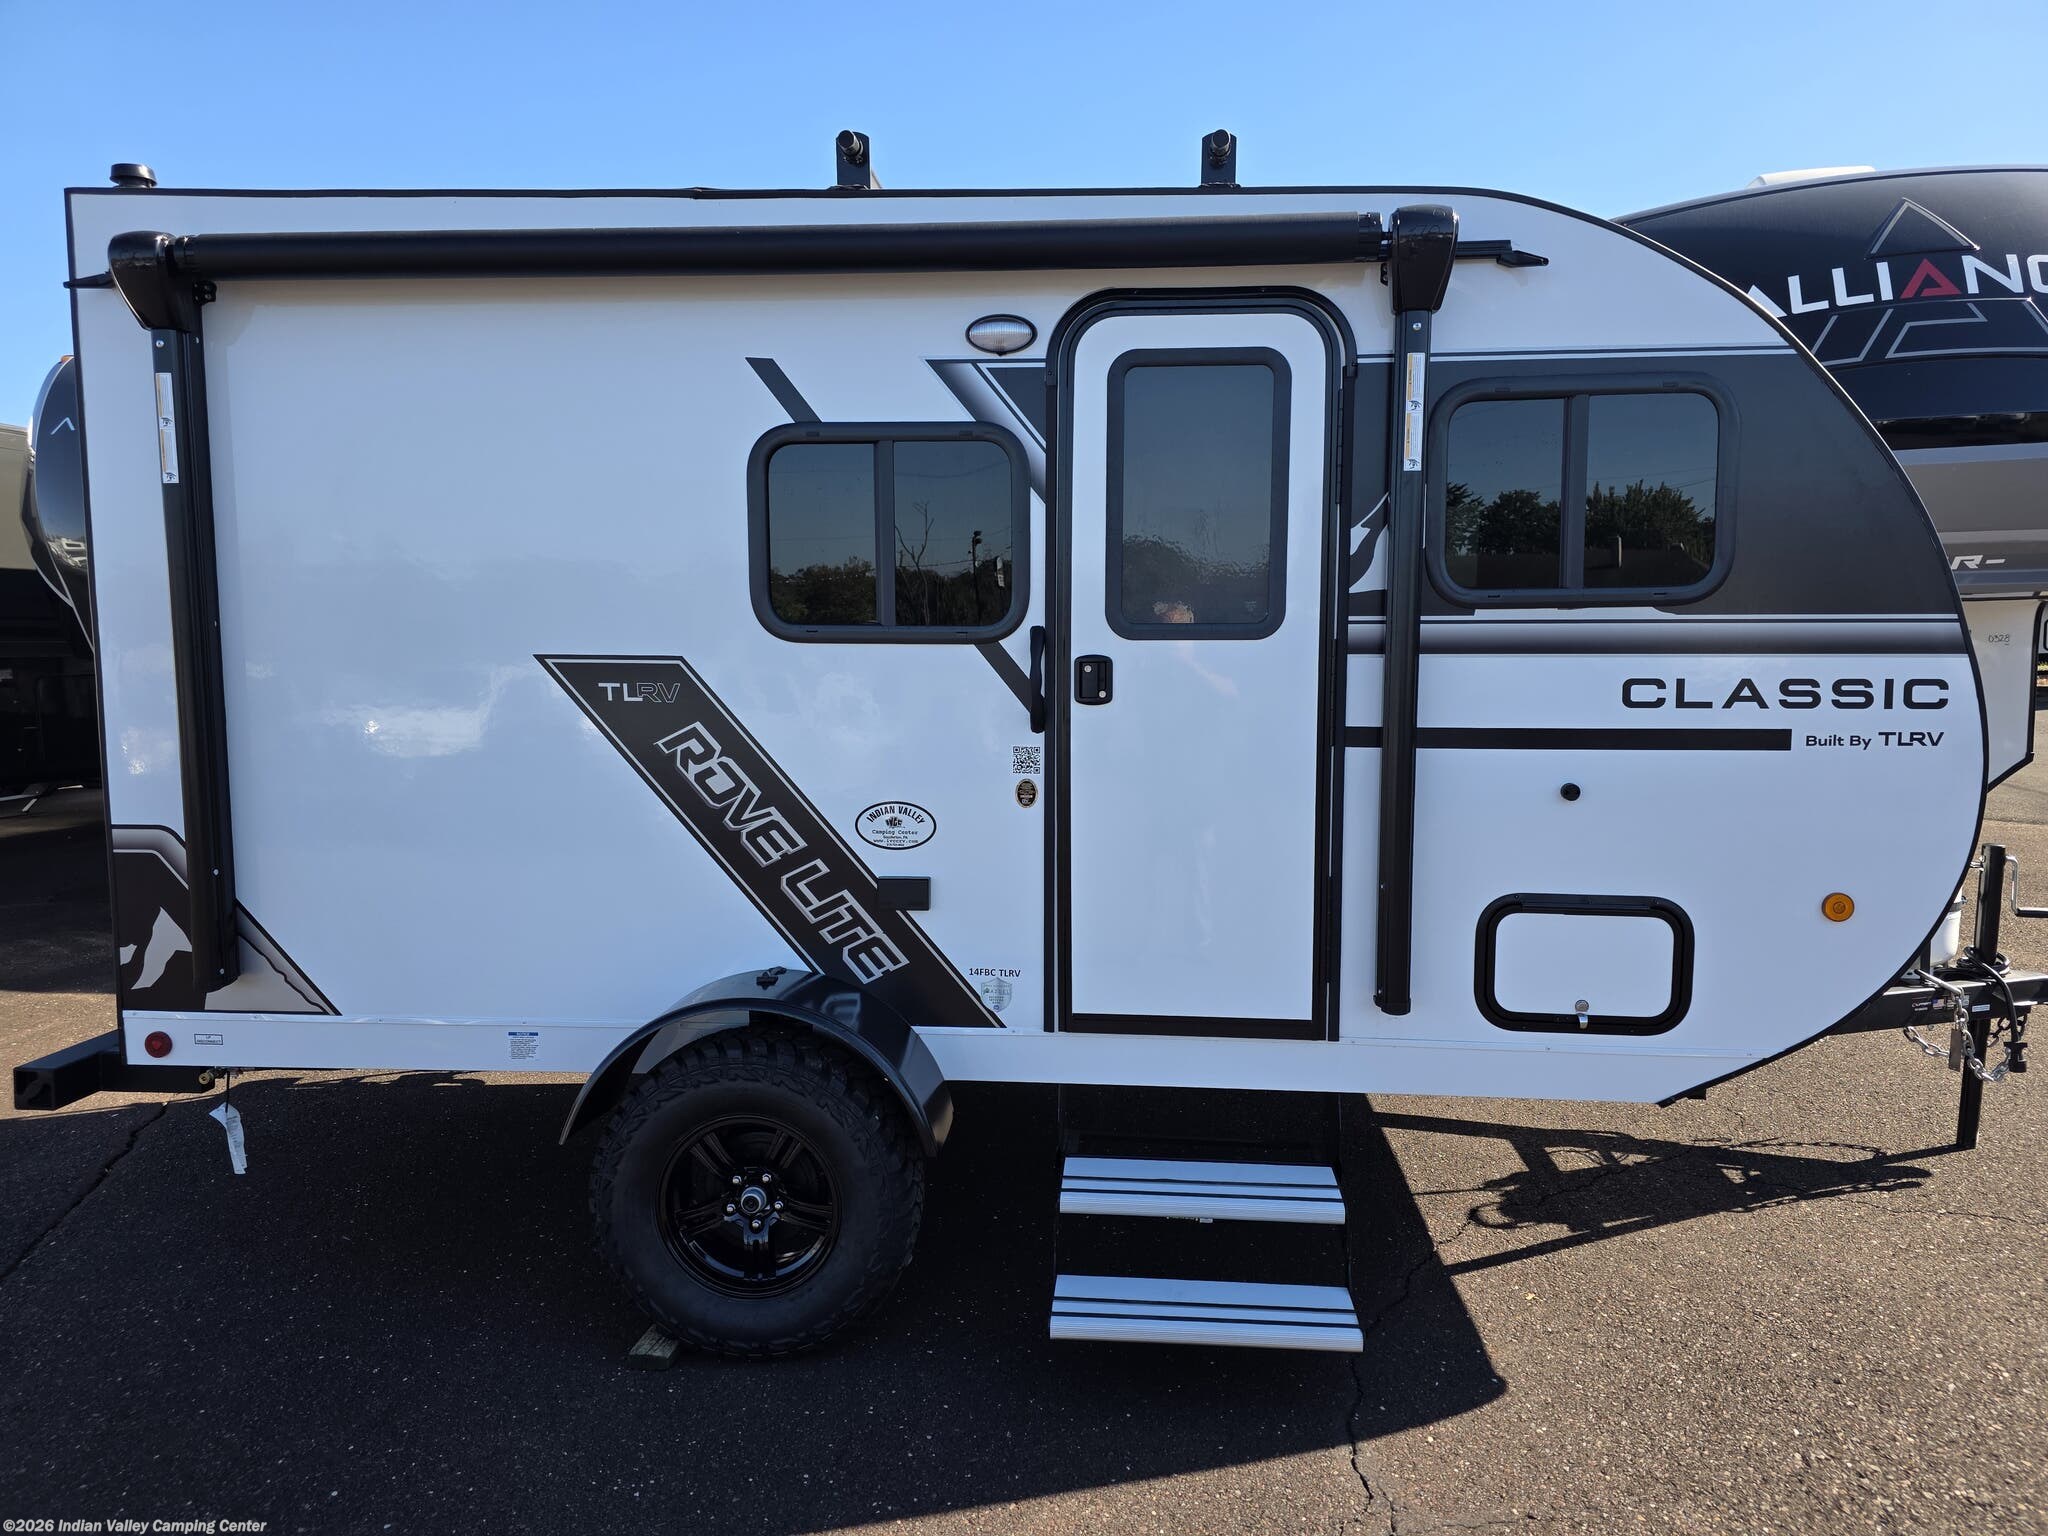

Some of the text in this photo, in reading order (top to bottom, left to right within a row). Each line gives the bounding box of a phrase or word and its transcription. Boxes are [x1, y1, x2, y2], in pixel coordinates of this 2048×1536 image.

[598, 682, 681, 704] TLRV
[1621, 678, 1950, 710] CLASSIC
[1804, 731, 1946, 751] Built By TLRV
[653, 721, 809, 868] ROVE
[866, 805, 926, 824] INDIAN VALLEY
[968, 967, 1022, 978] 14FBC TLRV
